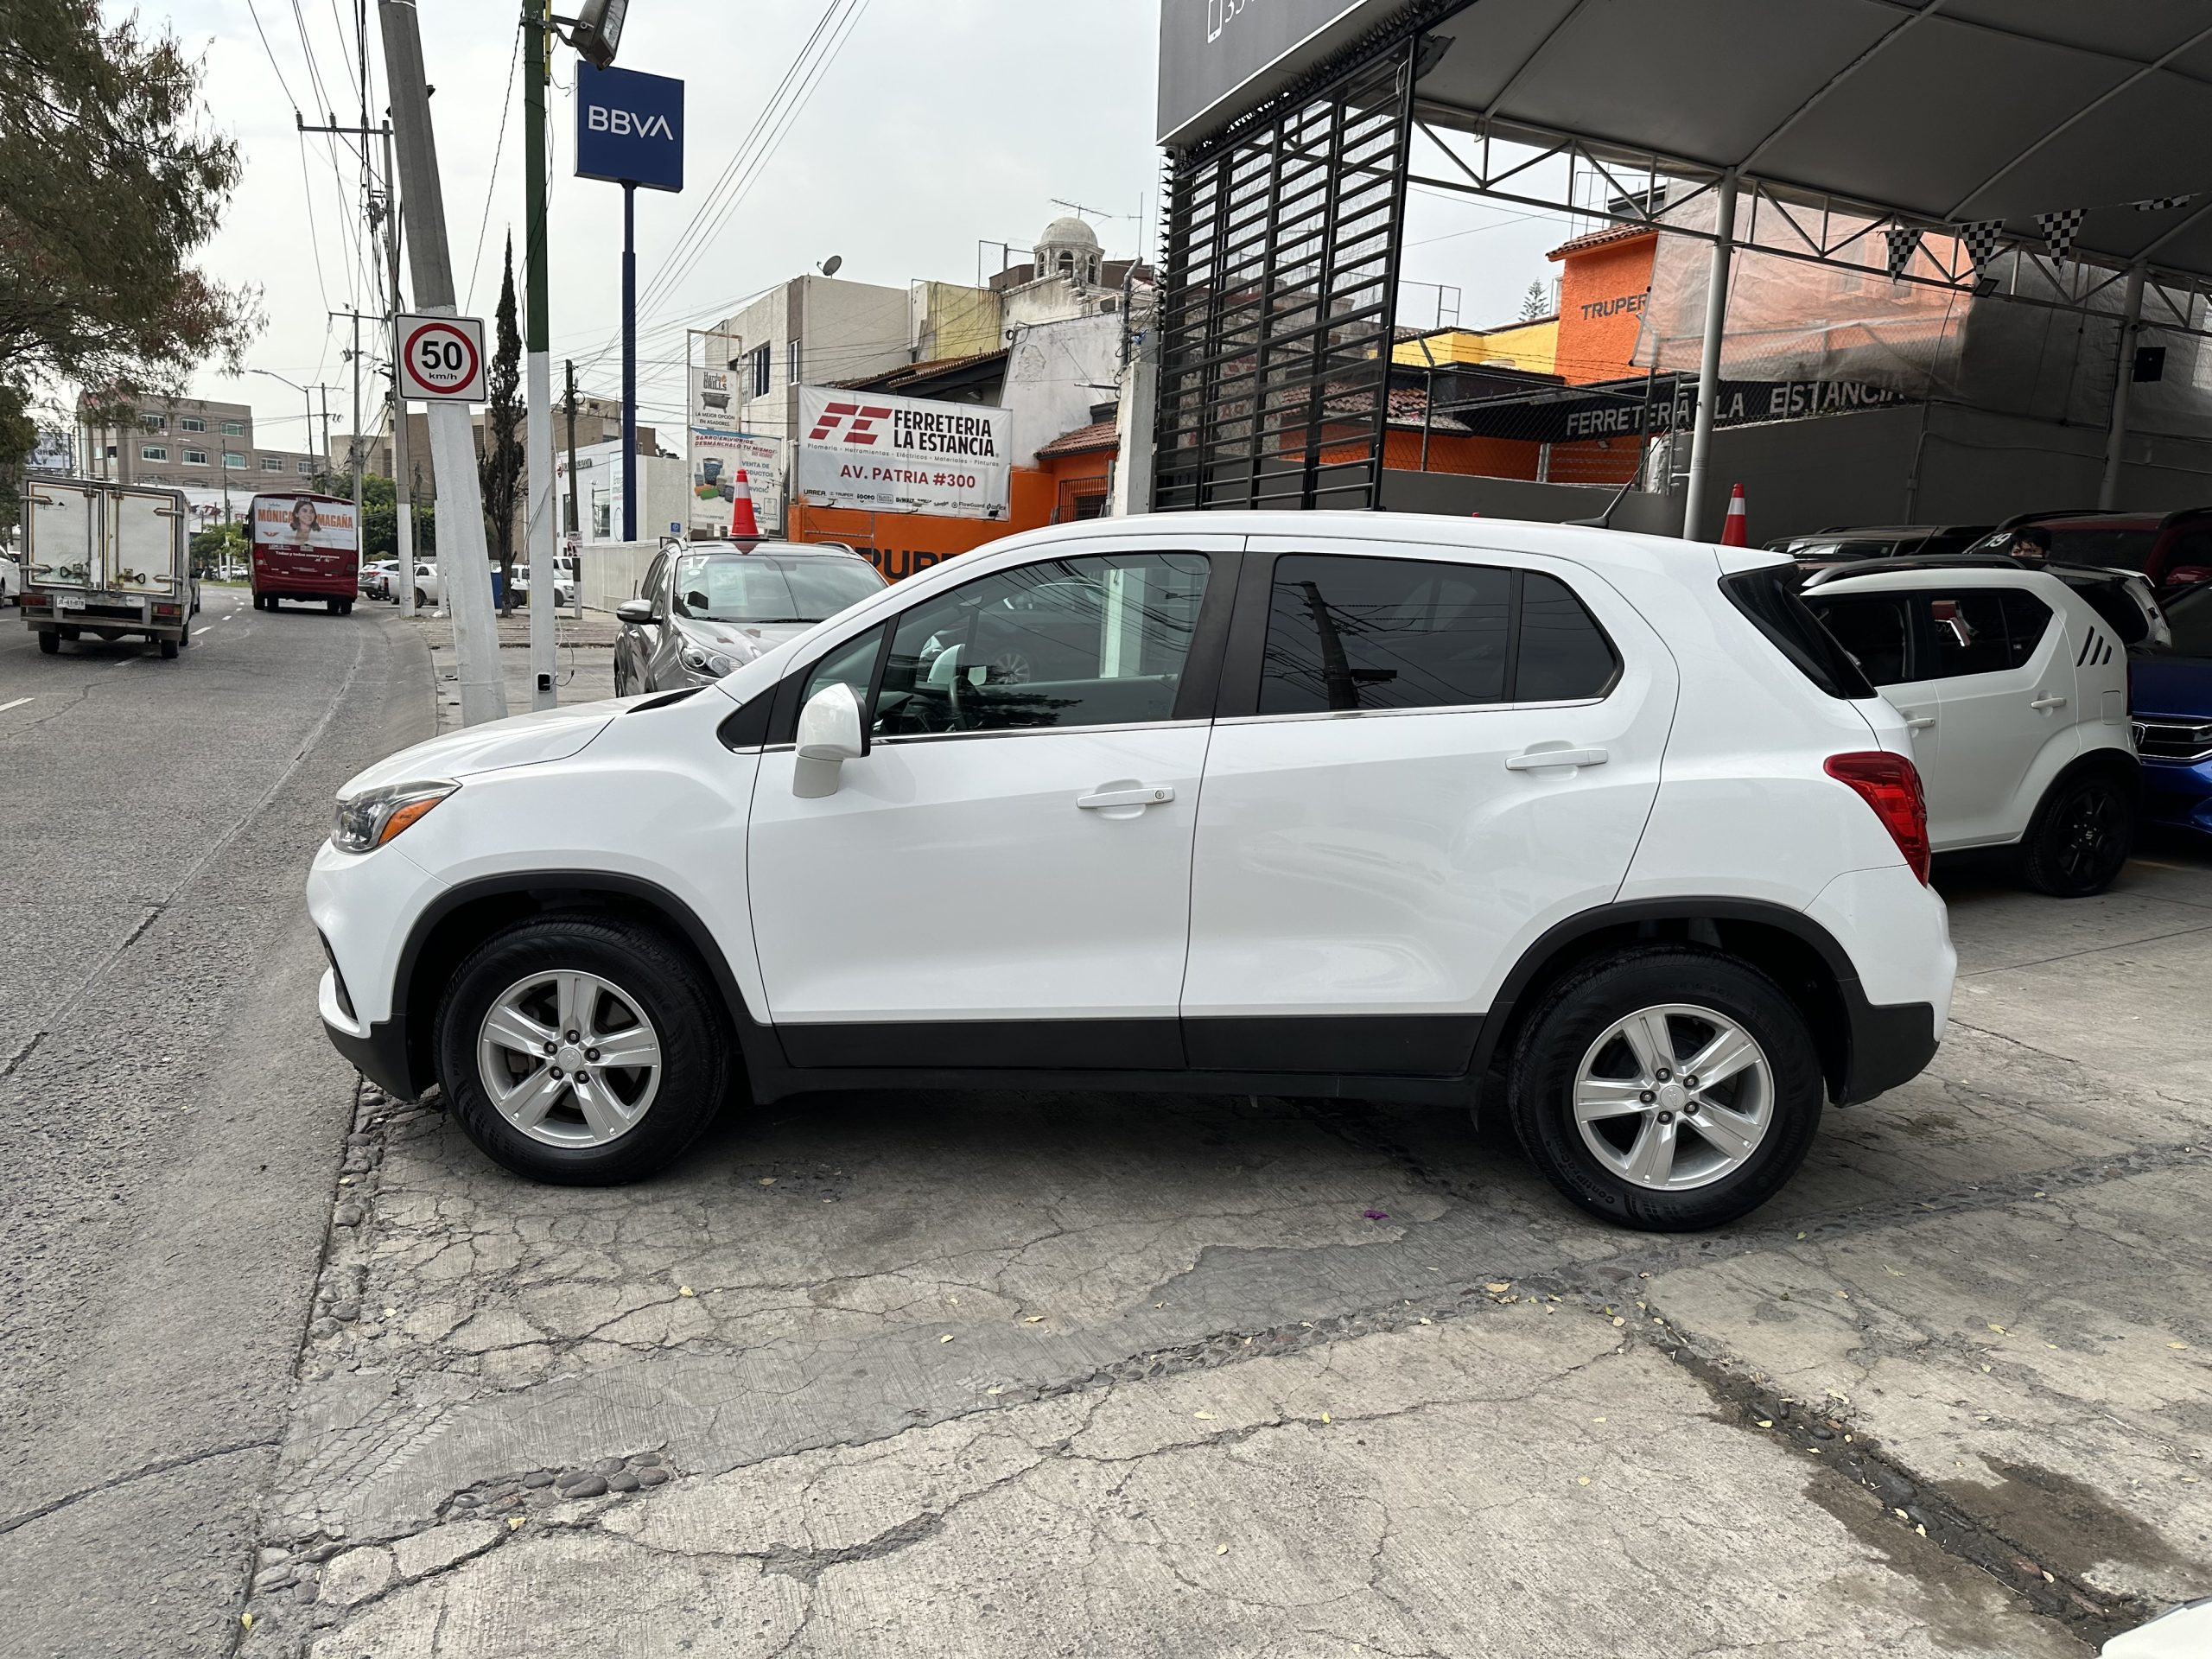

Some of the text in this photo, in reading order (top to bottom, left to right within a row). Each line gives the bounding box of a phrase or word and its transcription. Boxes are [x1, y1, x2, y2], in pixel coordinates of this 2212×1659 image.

[588, 105, 674, 141] BBVA
[1581, 293, 1648, 321] TRUPER
[421, 340, 463, 371] 50
[429, 372, 458, 380] km/h
[702, 379, 728, 391] GRILLS
[1713, 391, 1745, 420] LA
[893, 409, 992, 438] FERRETERIA
[893, 429, 995, 457] LA ESTANCIA
[934, 455, 968, 465] Materiales
[974, 459, 1000, 467] Pinturas
[840, 464, 976, 488] AV. PATRIA #300
[257, 507, 294, 524] MÓNICA
[317, 513, 353, 529] MAGAÑA
[1984, 532, 2012, 548] 19
[682, 556, 710, 570] 17
